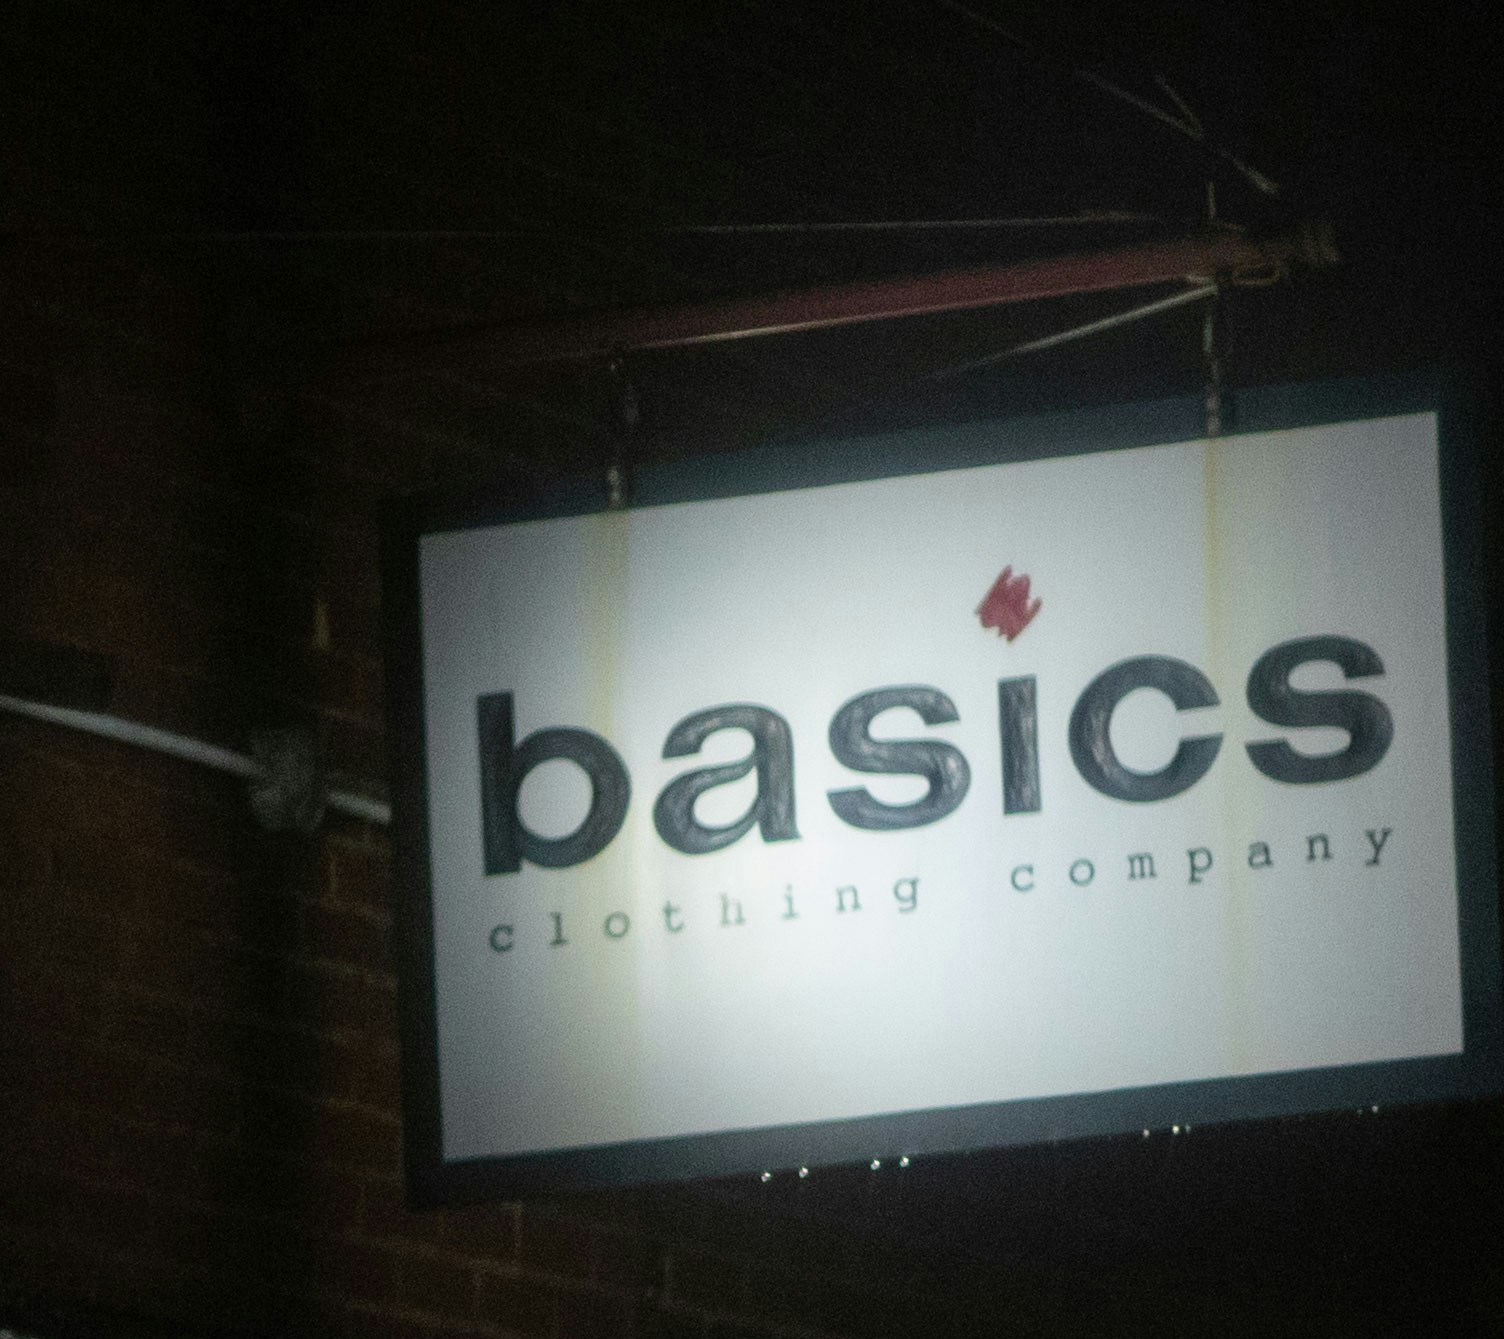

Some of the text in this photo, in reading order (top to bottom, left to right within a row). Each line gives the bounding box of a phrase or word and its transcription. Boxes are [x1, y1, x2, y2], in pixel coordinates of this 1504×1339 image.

[476, 564, 1395, 877] basics
[488, 825, 1394, 954] clothing company
